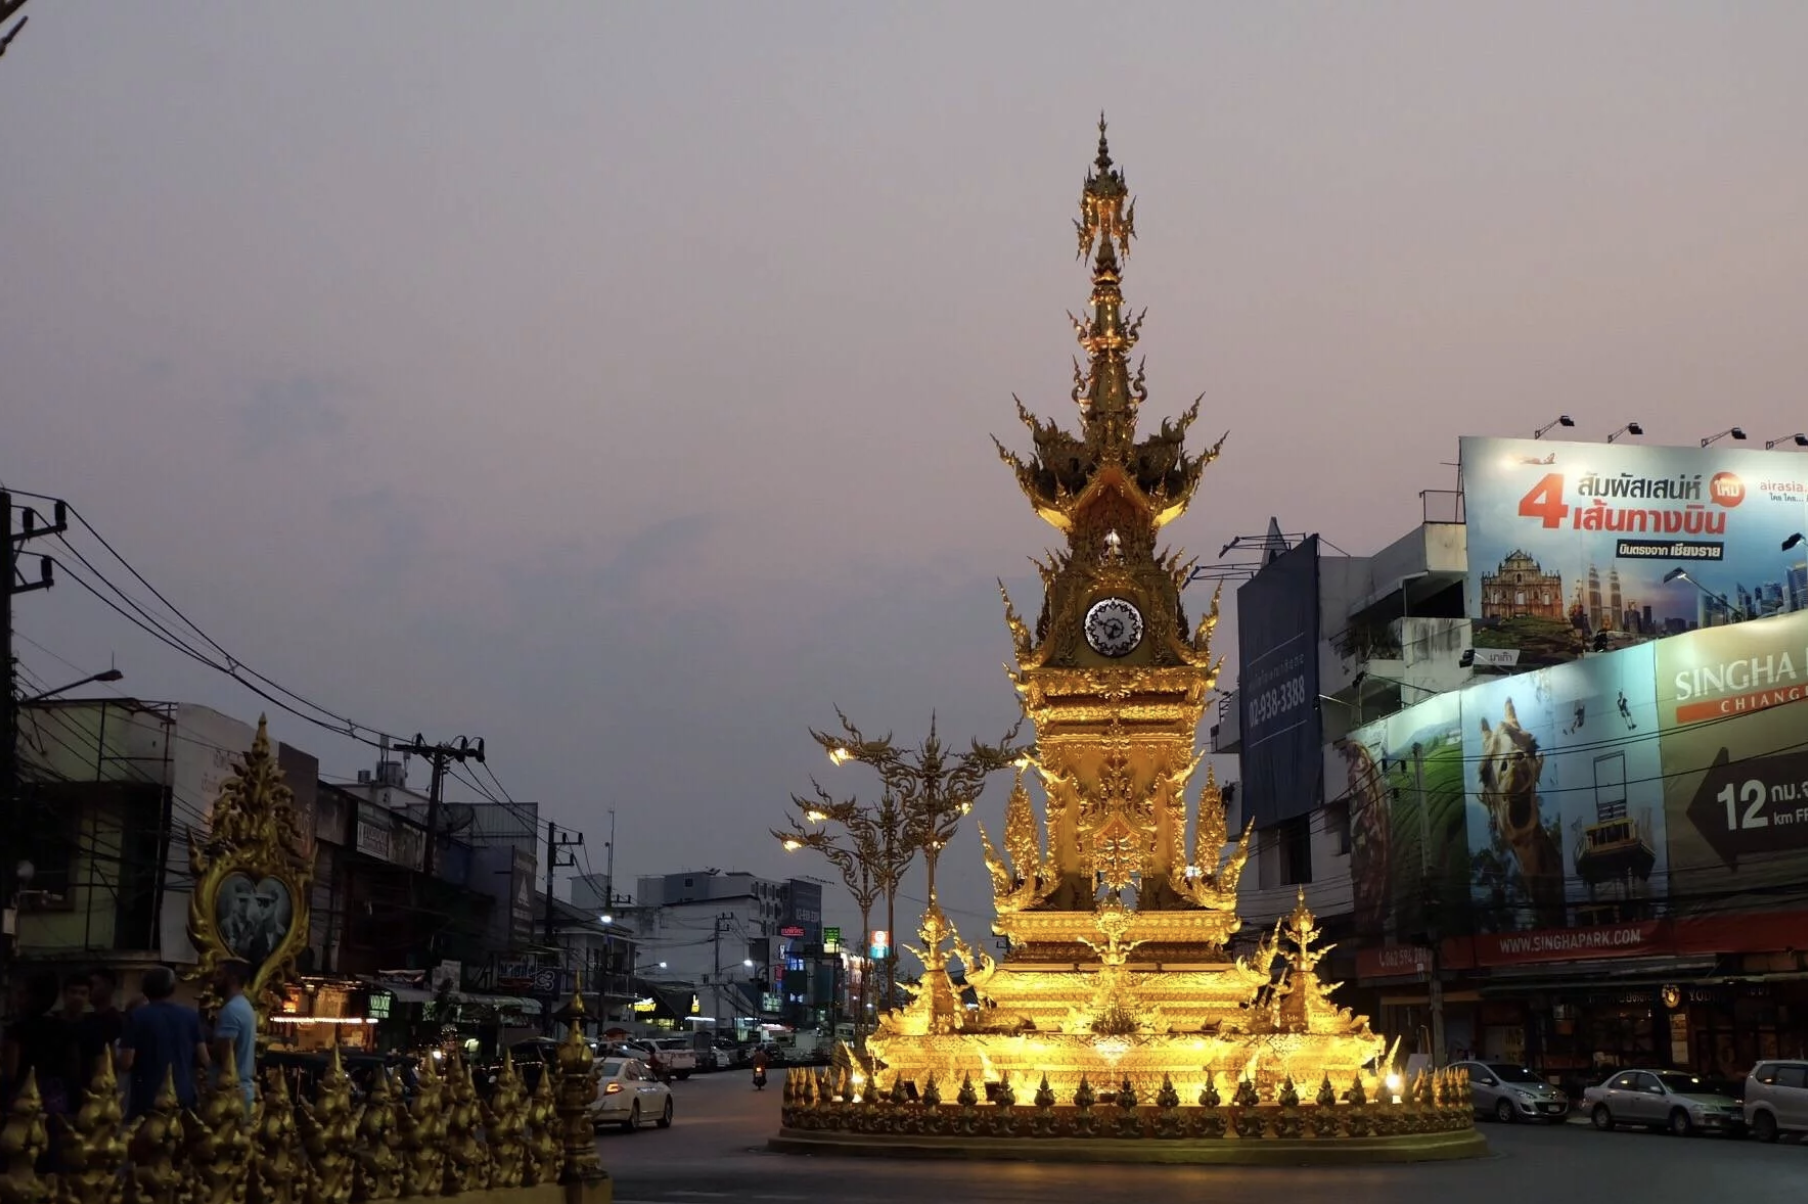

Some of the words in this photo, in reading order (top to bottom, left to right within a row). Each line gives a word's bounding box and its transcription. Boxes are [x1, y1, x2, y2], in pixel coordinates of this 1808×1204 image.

[1518, 473, 1568, 529] 4
[1572, 498, 1727, 535] เส้นทางบิน
[1619, 543, 1669, 556] บินตรงจาก
[1670, 542, 1721, 558] เชียงราย
[1249, 674, 1305, 728] 02-938-3388
[1675, 651, 1797, 701] SINGHA
[1717, 779, 1769, 831] 12
[1773, 811, 1794, 826] km
[1500, 928, 1641, 954] WWW.SINGHAPARK.COM
